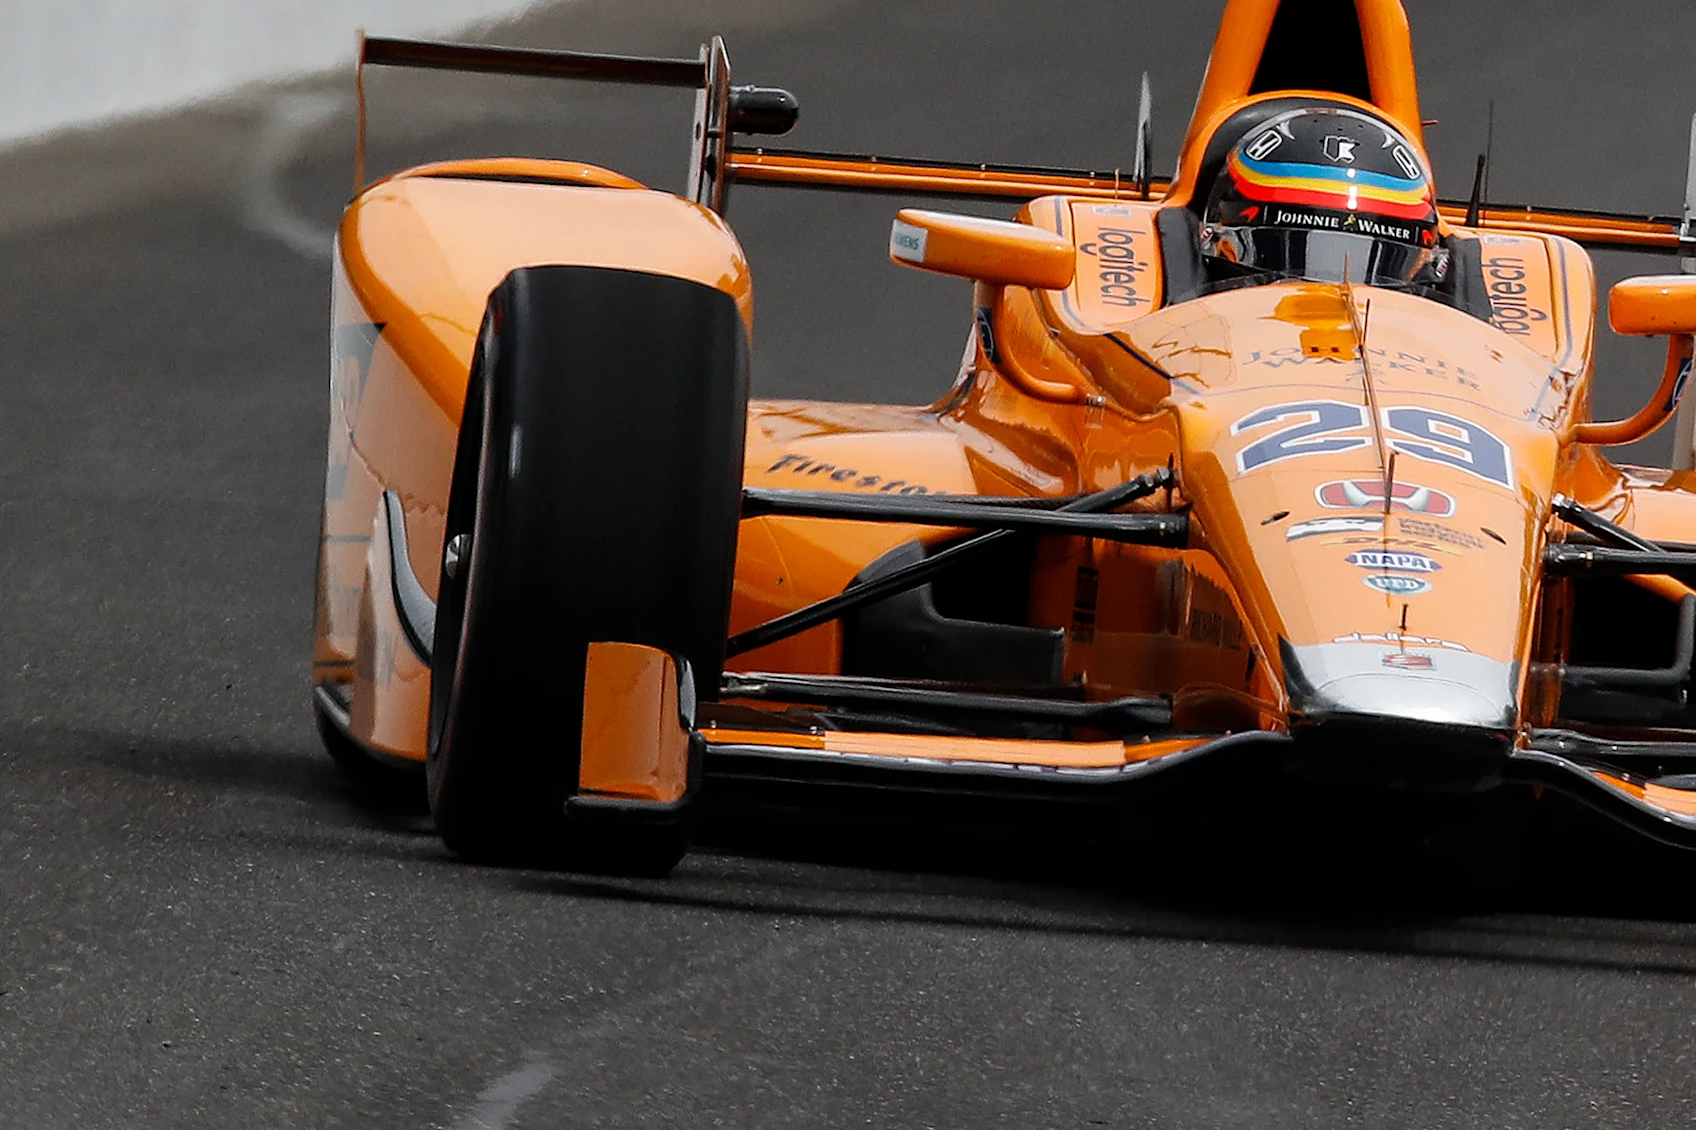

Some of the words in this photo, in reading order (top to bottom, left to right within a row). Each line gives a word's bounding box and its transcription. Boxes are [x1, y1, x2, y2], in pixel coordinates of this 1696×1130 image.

[1274, 210, 1340, 228] JOHNNIE
[1358, 219, 1411, 240] WALKER
[1079, 227, 1151, 307] logitech
[1230, 399, 1516, 491] 29
[764, 453, 948, 495] Firesto
[1361, 554, 1428, 569] NAPA
